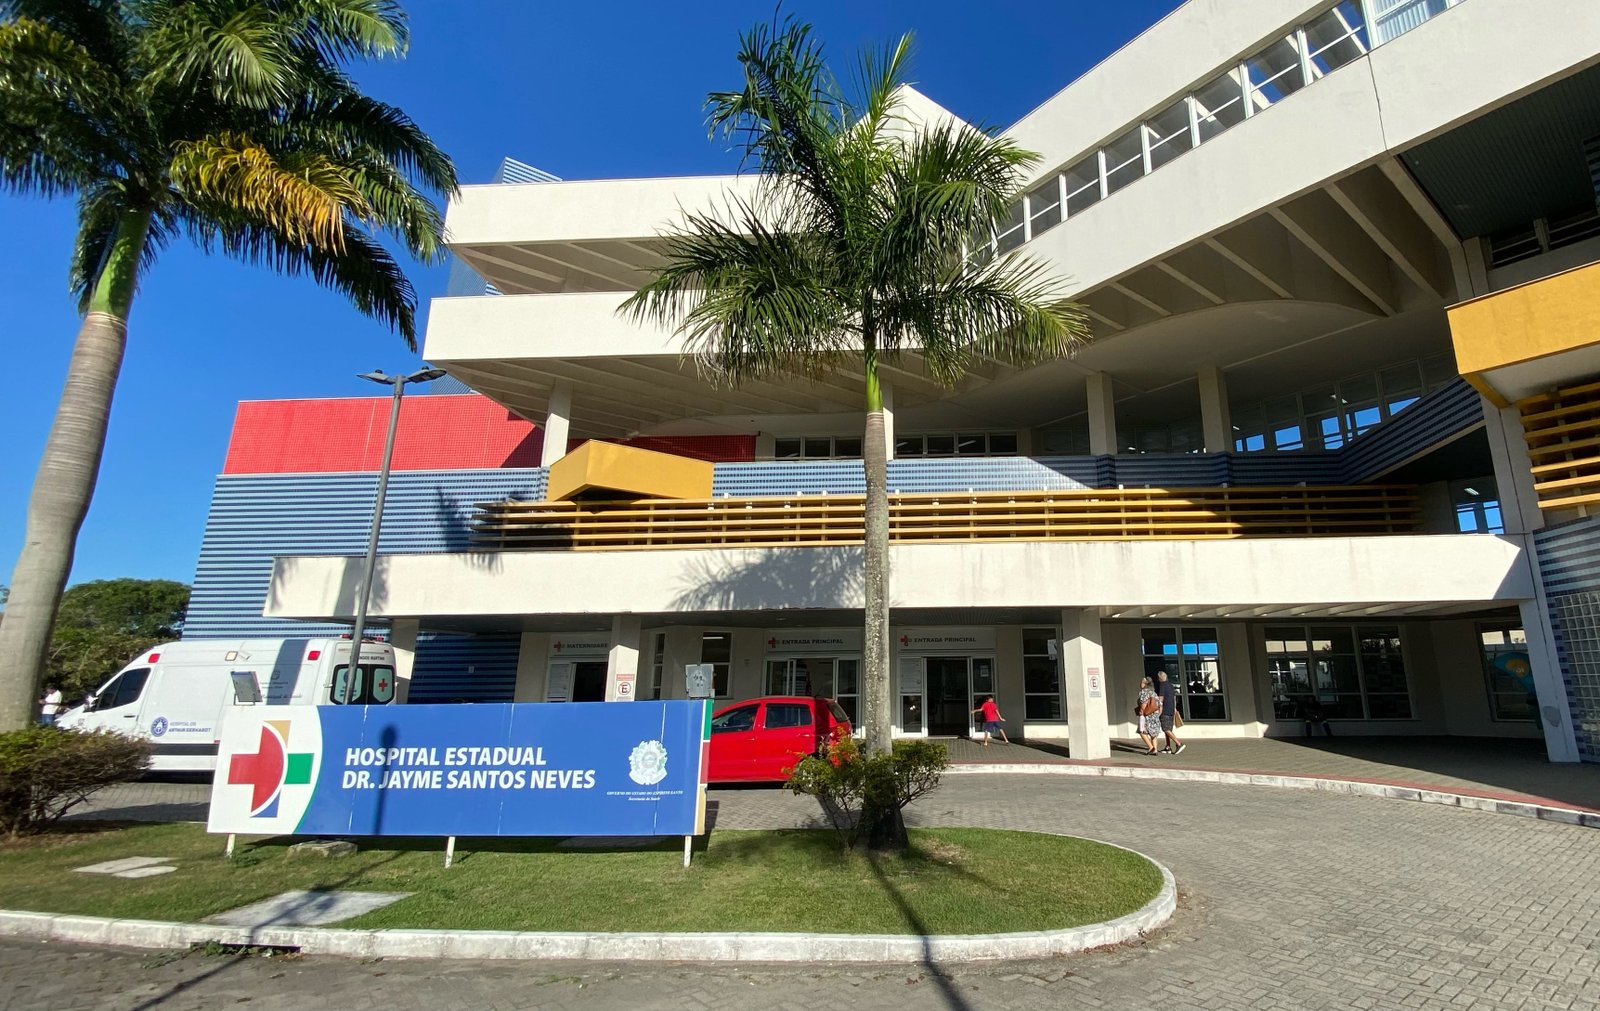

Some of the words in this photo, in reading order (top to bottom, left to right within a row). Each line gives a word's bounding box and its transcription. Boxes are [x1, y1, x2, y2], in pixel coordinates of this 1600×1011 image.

[345, 747, 440, 766] HOSPITAL
[444, 747, 547, 766] ESTADUAL
[342, 770, 375, 789] DR.
[378, 770, 443, 789] JAYME
[446, 769, 526, 789] SANTOS
[530, 769, 596, 789] NEVES
